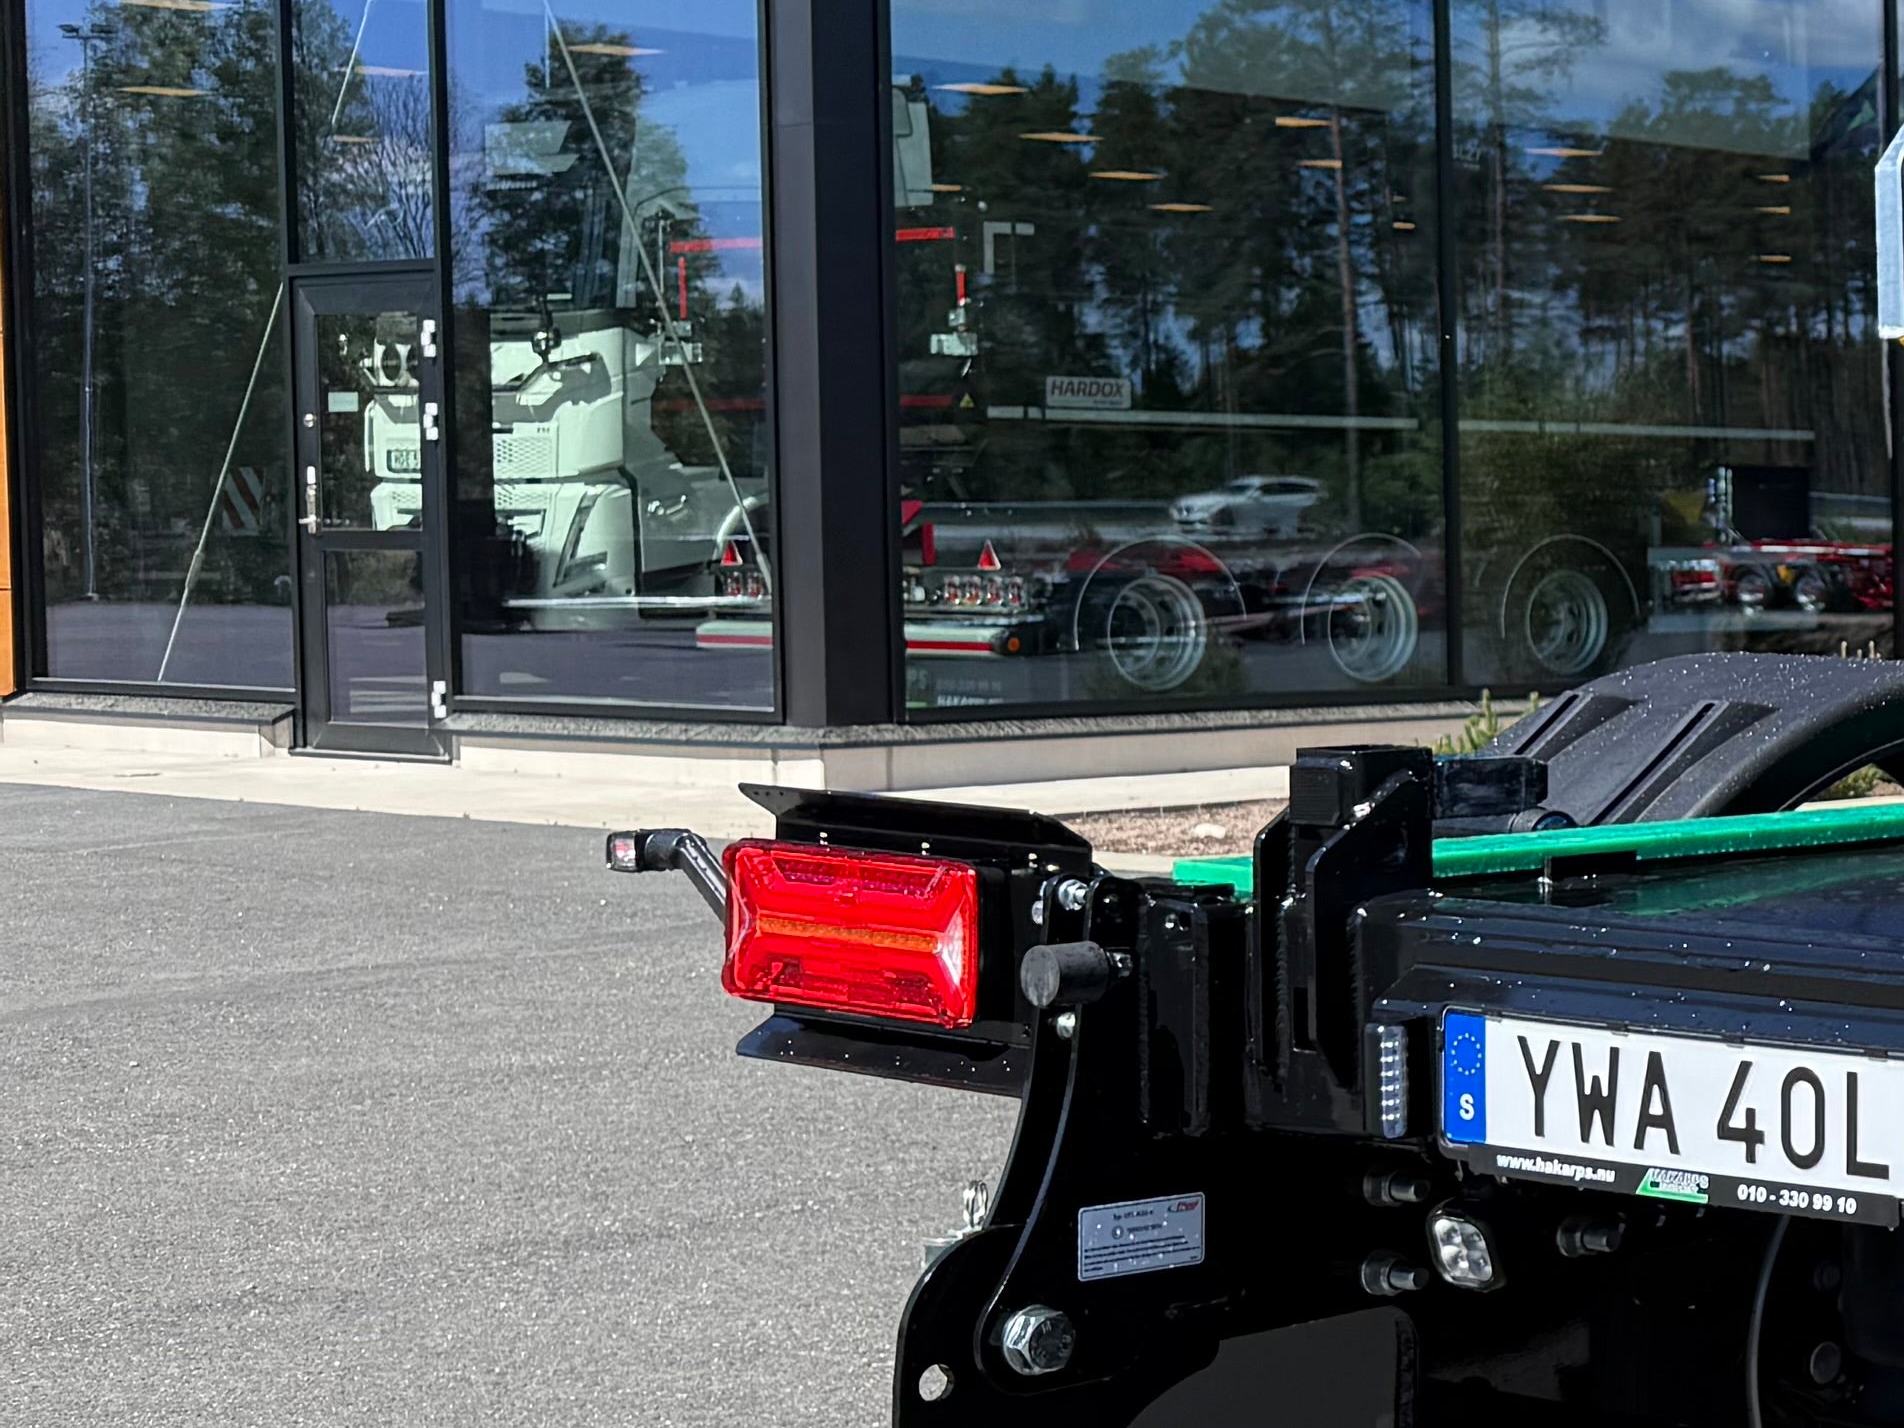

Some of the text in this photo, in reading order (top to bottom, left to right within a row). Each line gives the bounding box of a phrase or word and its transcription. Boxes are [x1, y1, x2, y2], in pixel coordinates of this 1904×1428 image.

[1051, 379, 1124, 398] HARDOX
[1459, 1094, 1475, 1121] S
[1517, 1035, 1890, 1181] YWA 40L
[1496, 1154, 1616, 1184] www.hakarps.nu
[1737, 1184, 1767, 1203] 010
[1779, 1189, 1809, 1209] 330
[1812, 1193, 1833, 1211] 99
[1837, 1196, 1857, 1215] 10
